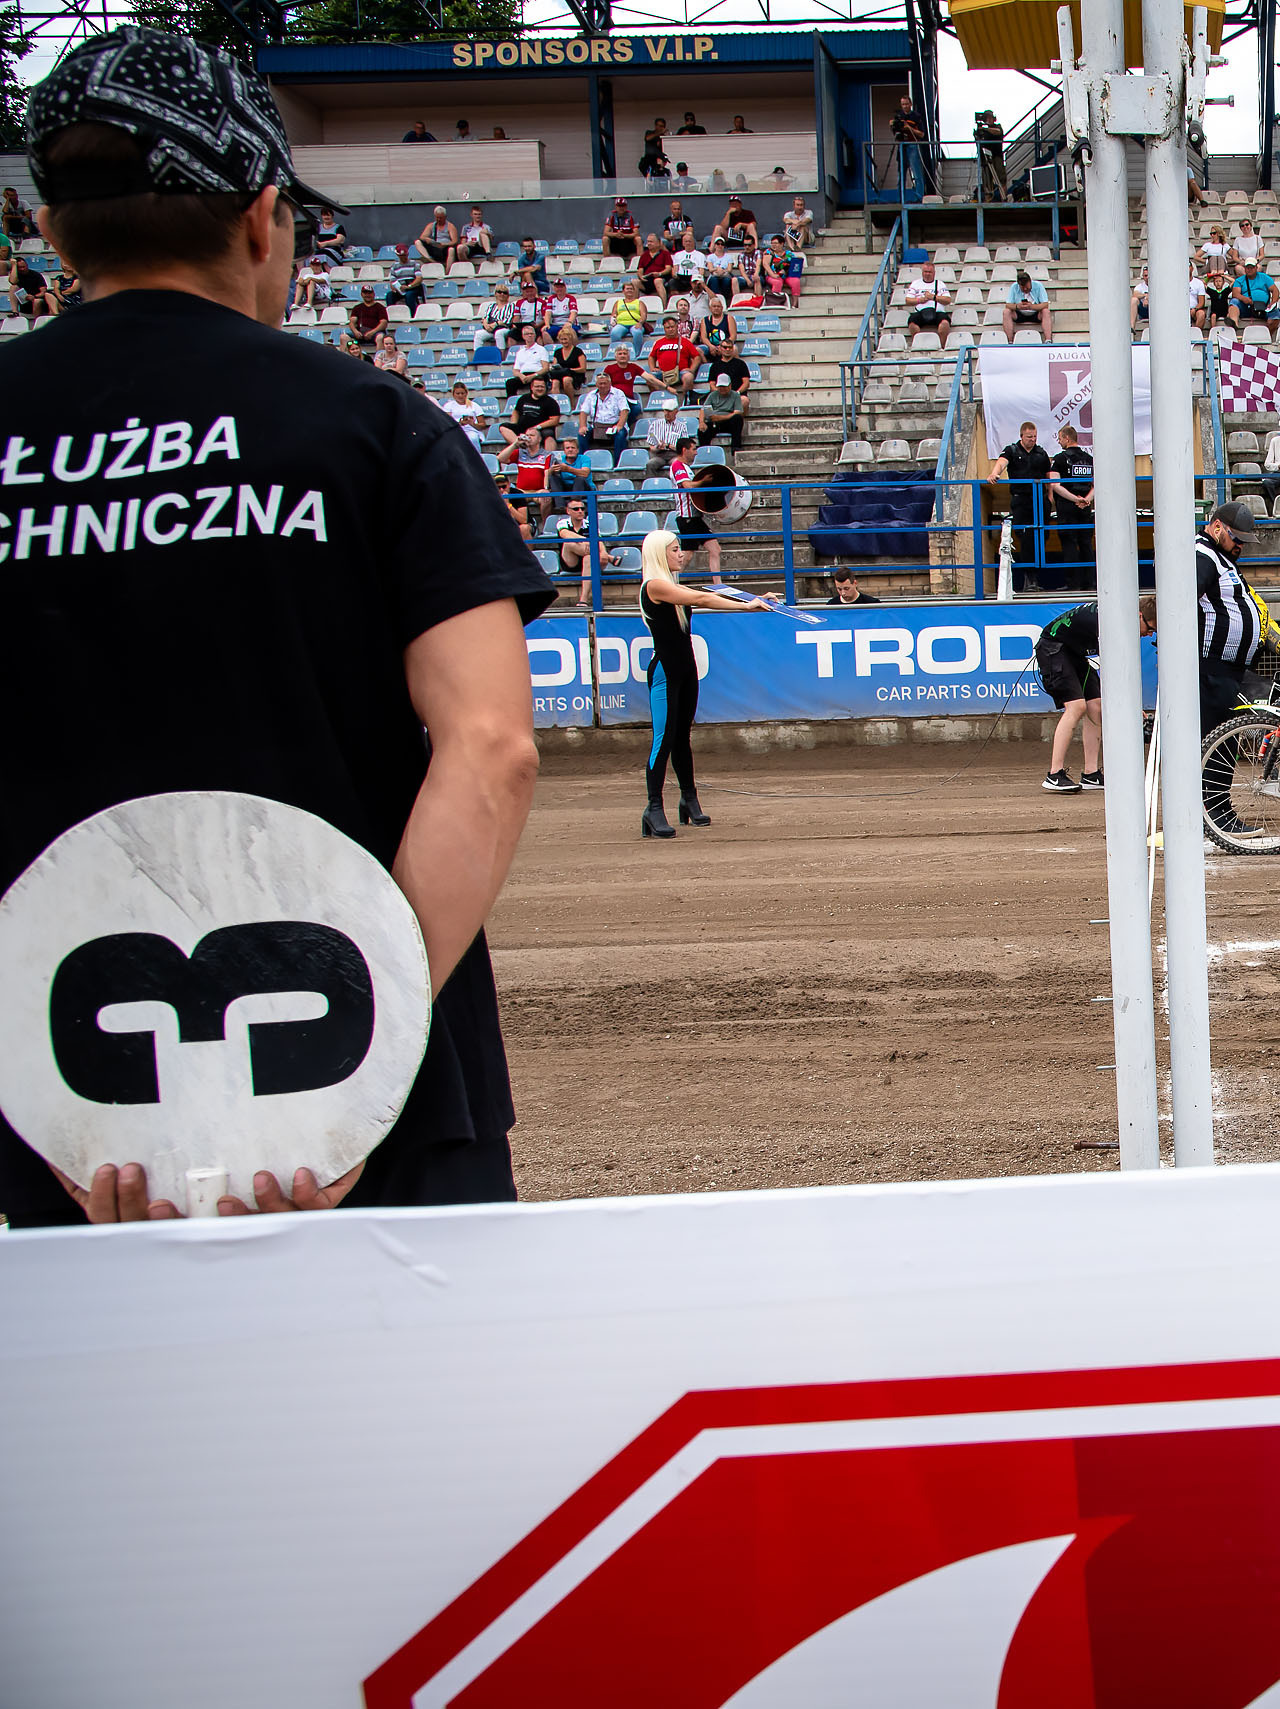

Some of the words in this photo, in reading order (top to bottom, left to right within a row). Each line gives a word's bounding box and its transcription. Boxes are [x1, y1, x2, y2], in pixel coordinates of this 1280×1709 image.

[452, 38, 634, 67] SPONSORS
[644, 37, 719, 62] V.I.P.
[0, 416, 240, 485] ŁUŻBA
[0, 484, 328, 564] HNICZNA
[795, 624, 1045, 678] TROD
[533, 696, 567, 712] RTS
[876, 686, 911, 702] CAR
[917, 685, 971, 701] PARTS
[976, 682, 1040, 699] ONLINE
[49, 920, 375, 1105] 3
